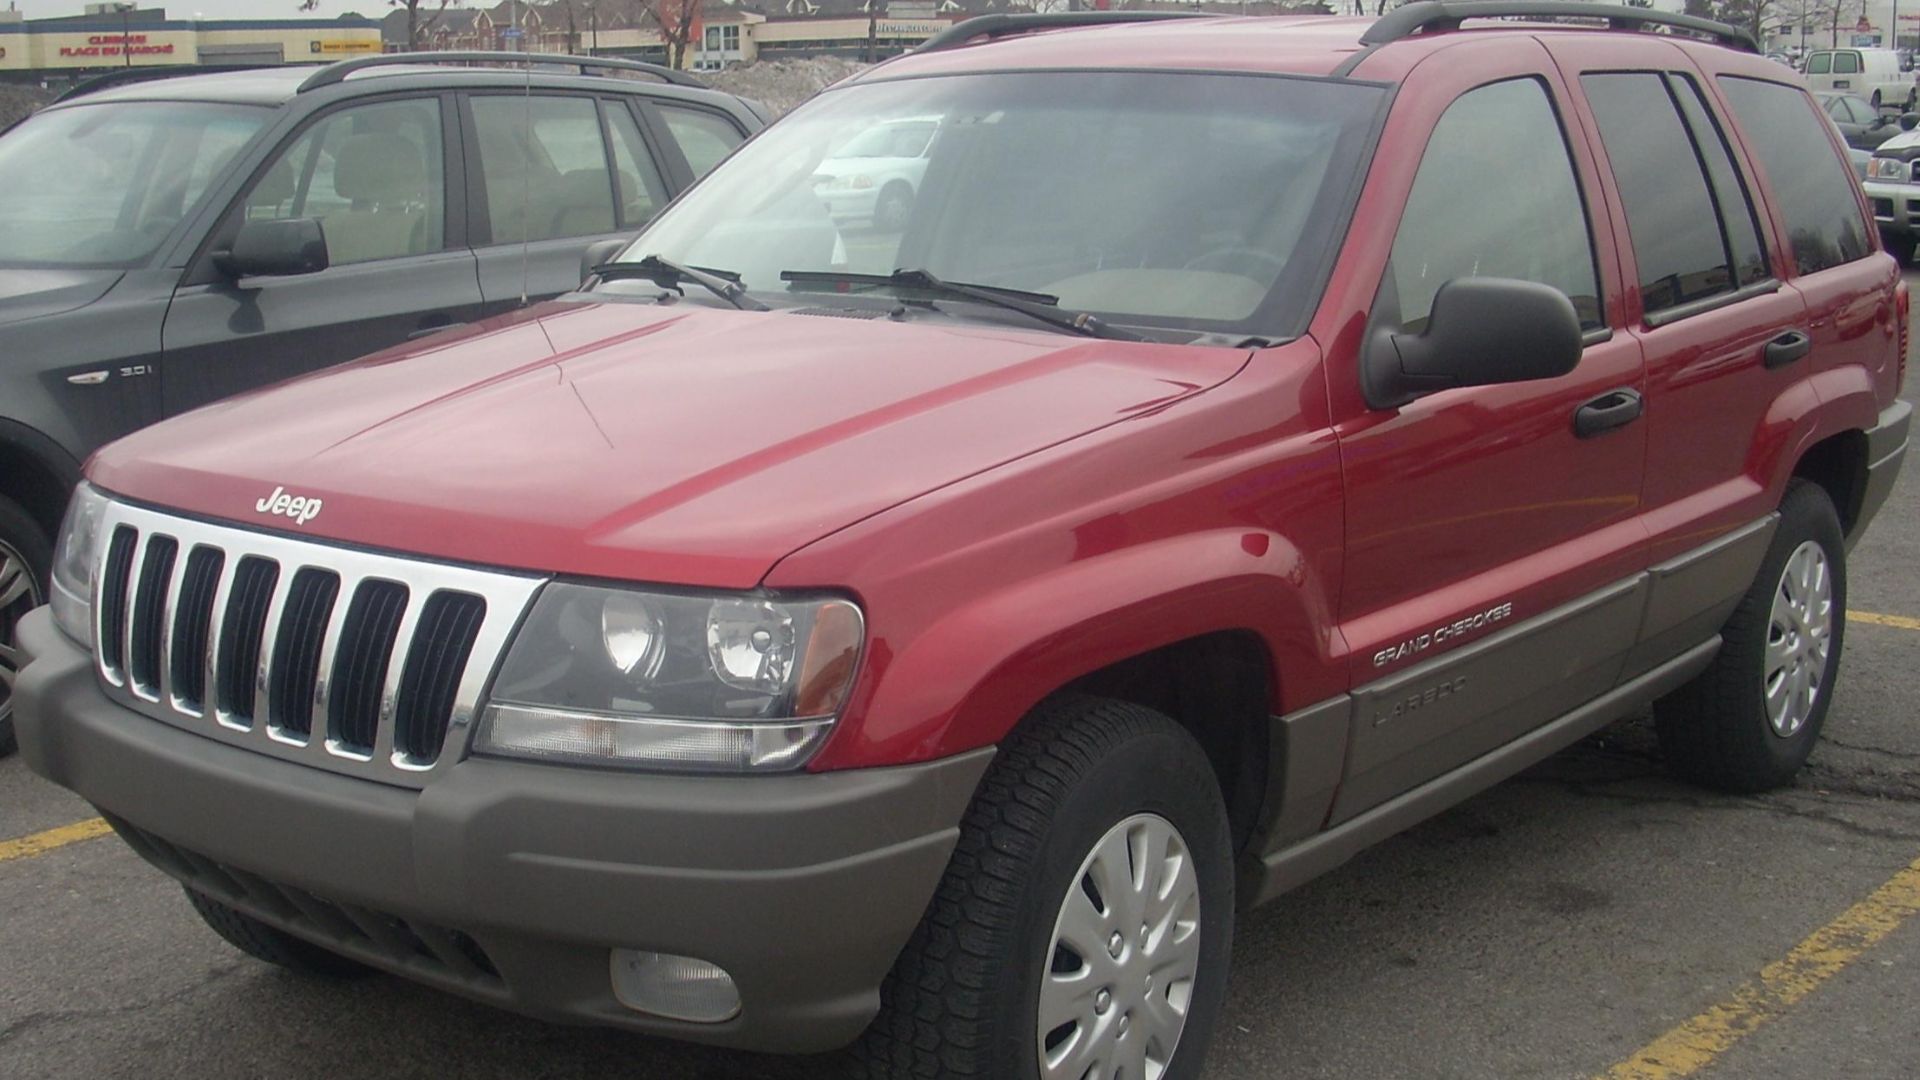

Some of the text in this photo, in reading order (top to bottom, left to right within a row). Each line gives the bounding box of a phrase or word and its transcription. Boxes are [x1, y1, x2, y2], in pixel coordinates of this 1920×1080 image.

[60, 47, 99, 57] PLACE
[102, 46, 120, 56] DU
[255, 486, 322, 526] Jeep
[1373, 602, 1512, 667] GRAND CHEROKEE
[1372, 675, 1467, 729] LAREDO
